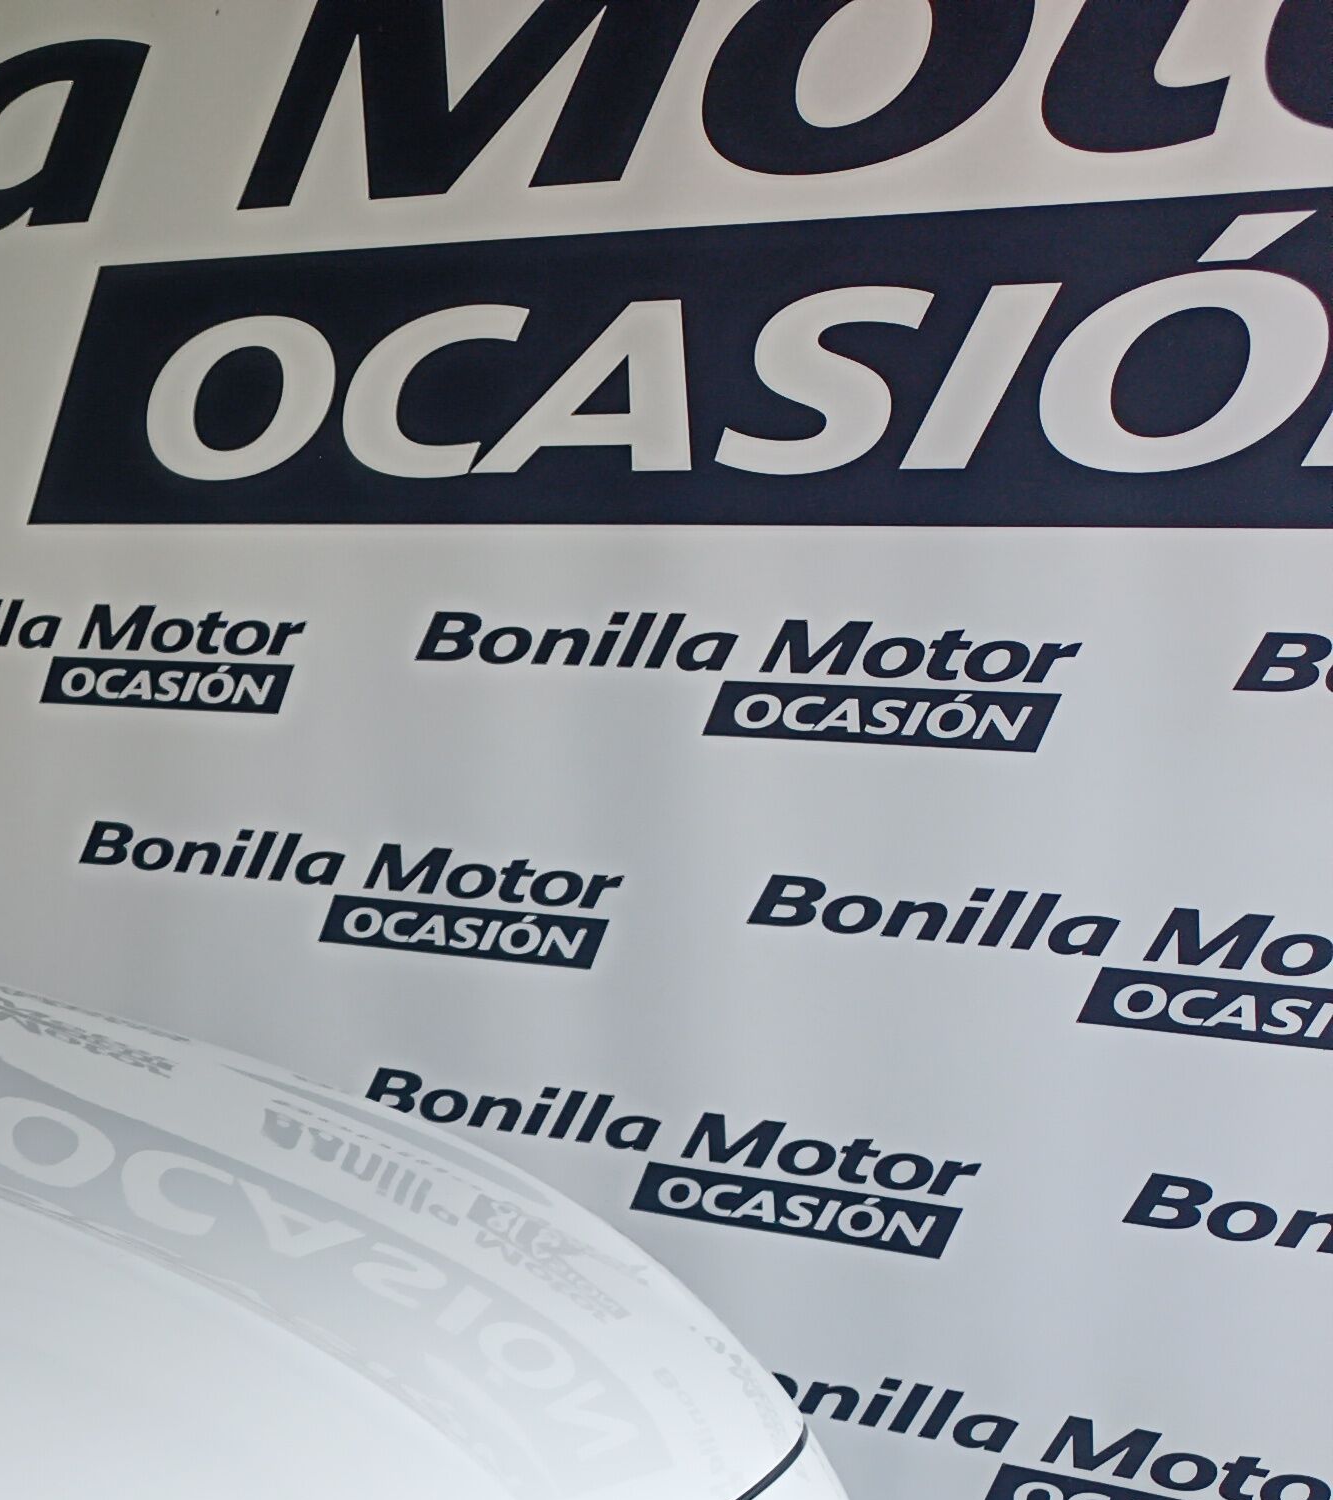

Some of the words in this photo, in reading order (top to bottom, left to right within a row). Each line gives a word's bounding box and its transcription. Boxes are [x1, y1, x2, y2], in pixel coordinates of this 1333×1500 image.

[77, 603, 308, 656] Motor
[414, 611, 739, 673] Bonilla
[758, 619, 1083, 684] Motor
[60, 665, 277, 706] OCASIÓN
[733, 694, 1035, 743] OCASIÓN
[78, 820, 346, 886] Bonilla
[362, 843, 625, 912] Motor
[342, 906, 592, 960] OCASIÓN
[746, 873, 1122, 958] Bonilla
[364, 1067, 662, 1153] Bonilla
[681, 1111, 982, 1197] Motor
[656, 1175, 937, 1248] OCASIÓN
